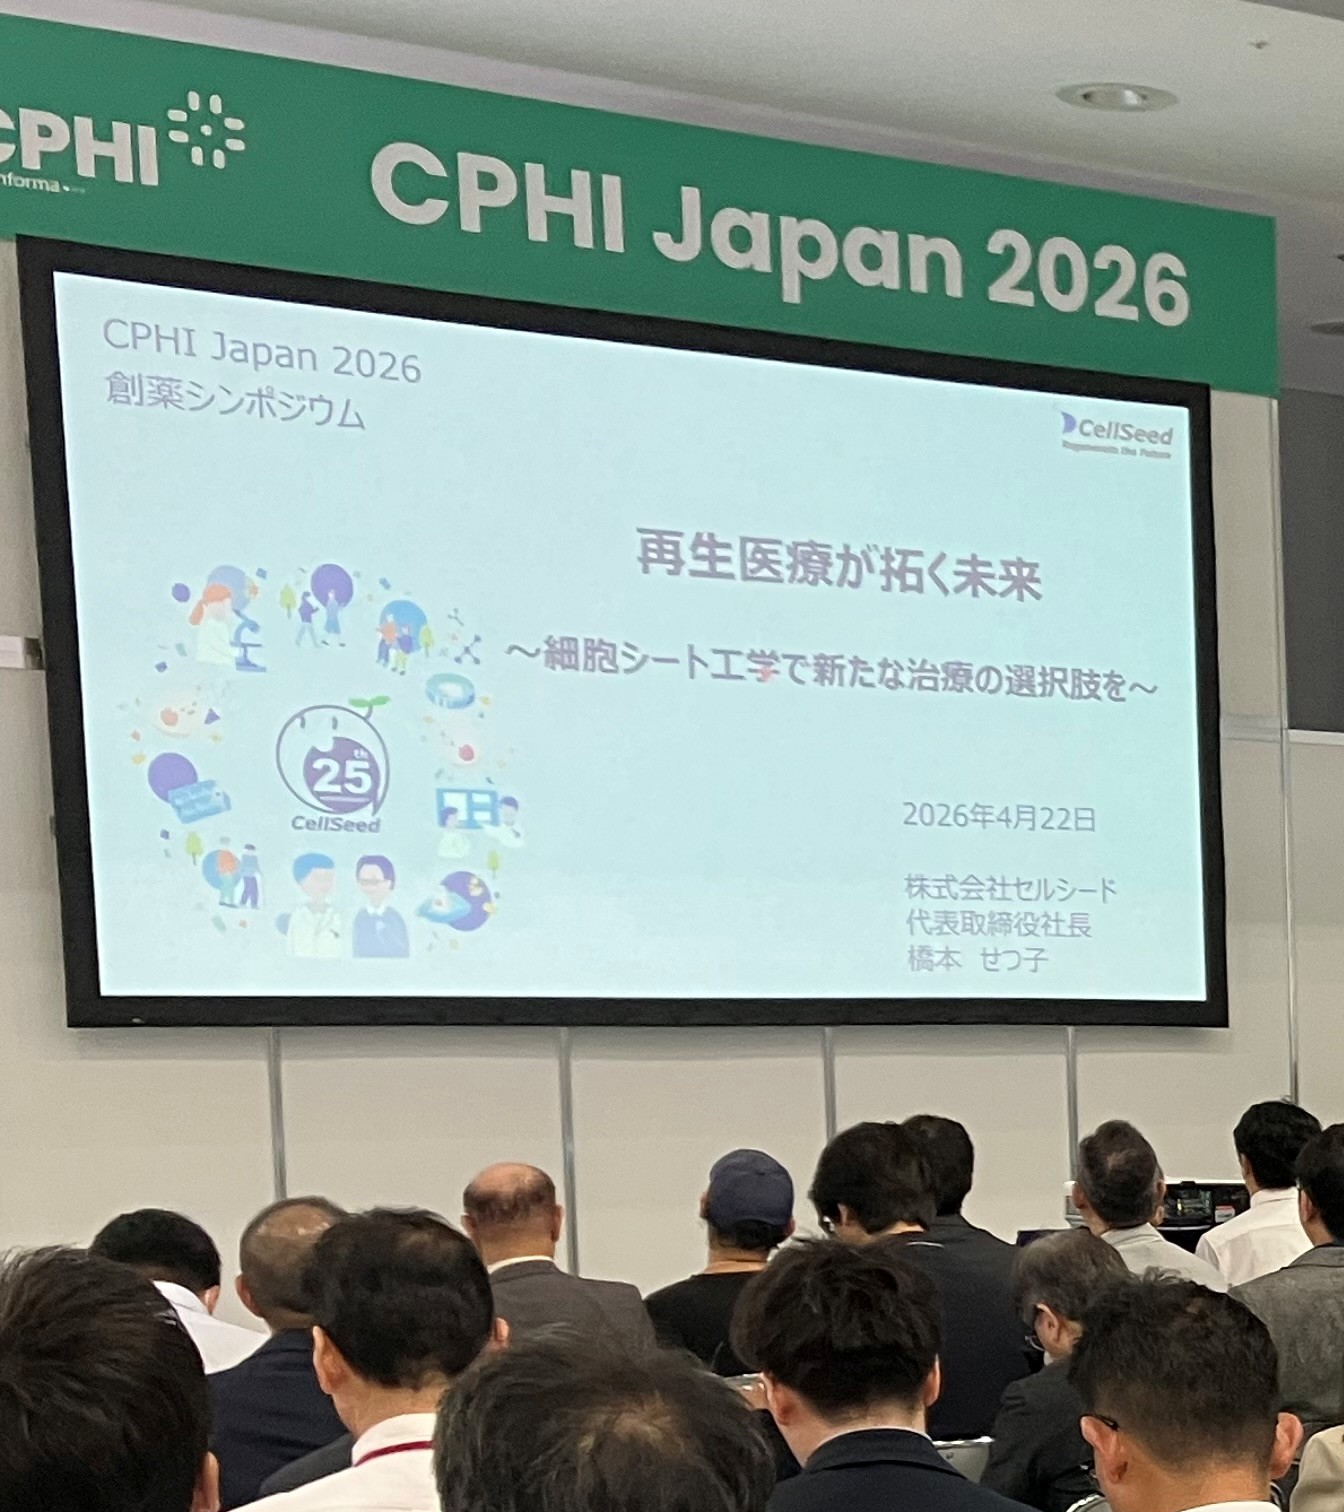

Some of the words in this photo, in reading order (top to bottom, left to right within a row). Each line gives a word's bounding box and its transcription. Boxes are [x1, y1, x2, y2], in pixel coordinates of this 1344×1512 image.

[0, 107, 159, 186] PHI
[0, 172, 61, 193] nforma
[371, 142, 625, 253] CPHI
[653, 186, 963, 304] Japan
[987, 229, 1191, 326] 2026
[103, 318, 197, 358] CPHI
[211, 331, 318, 372] Japan
[332, 346, 422, 384] 2026
[105, 370, 366, 430] 創薬シンポジウム
[1079, 418, 1173, 445] CellSeed
[635, 526, 1044, 602] 再生医療が拓く未来
[291, 815, 381, 833] CellSeed
[902, 801, 1096, 832] 2026年4月22日
[904, 873, 1118, 904] 株式会社セルシード
[905, 908, 1092, 938] 代表取締役社長
[907, 944, 963, 972] 橋本
[979, 946, 1049, 973] せつ子
